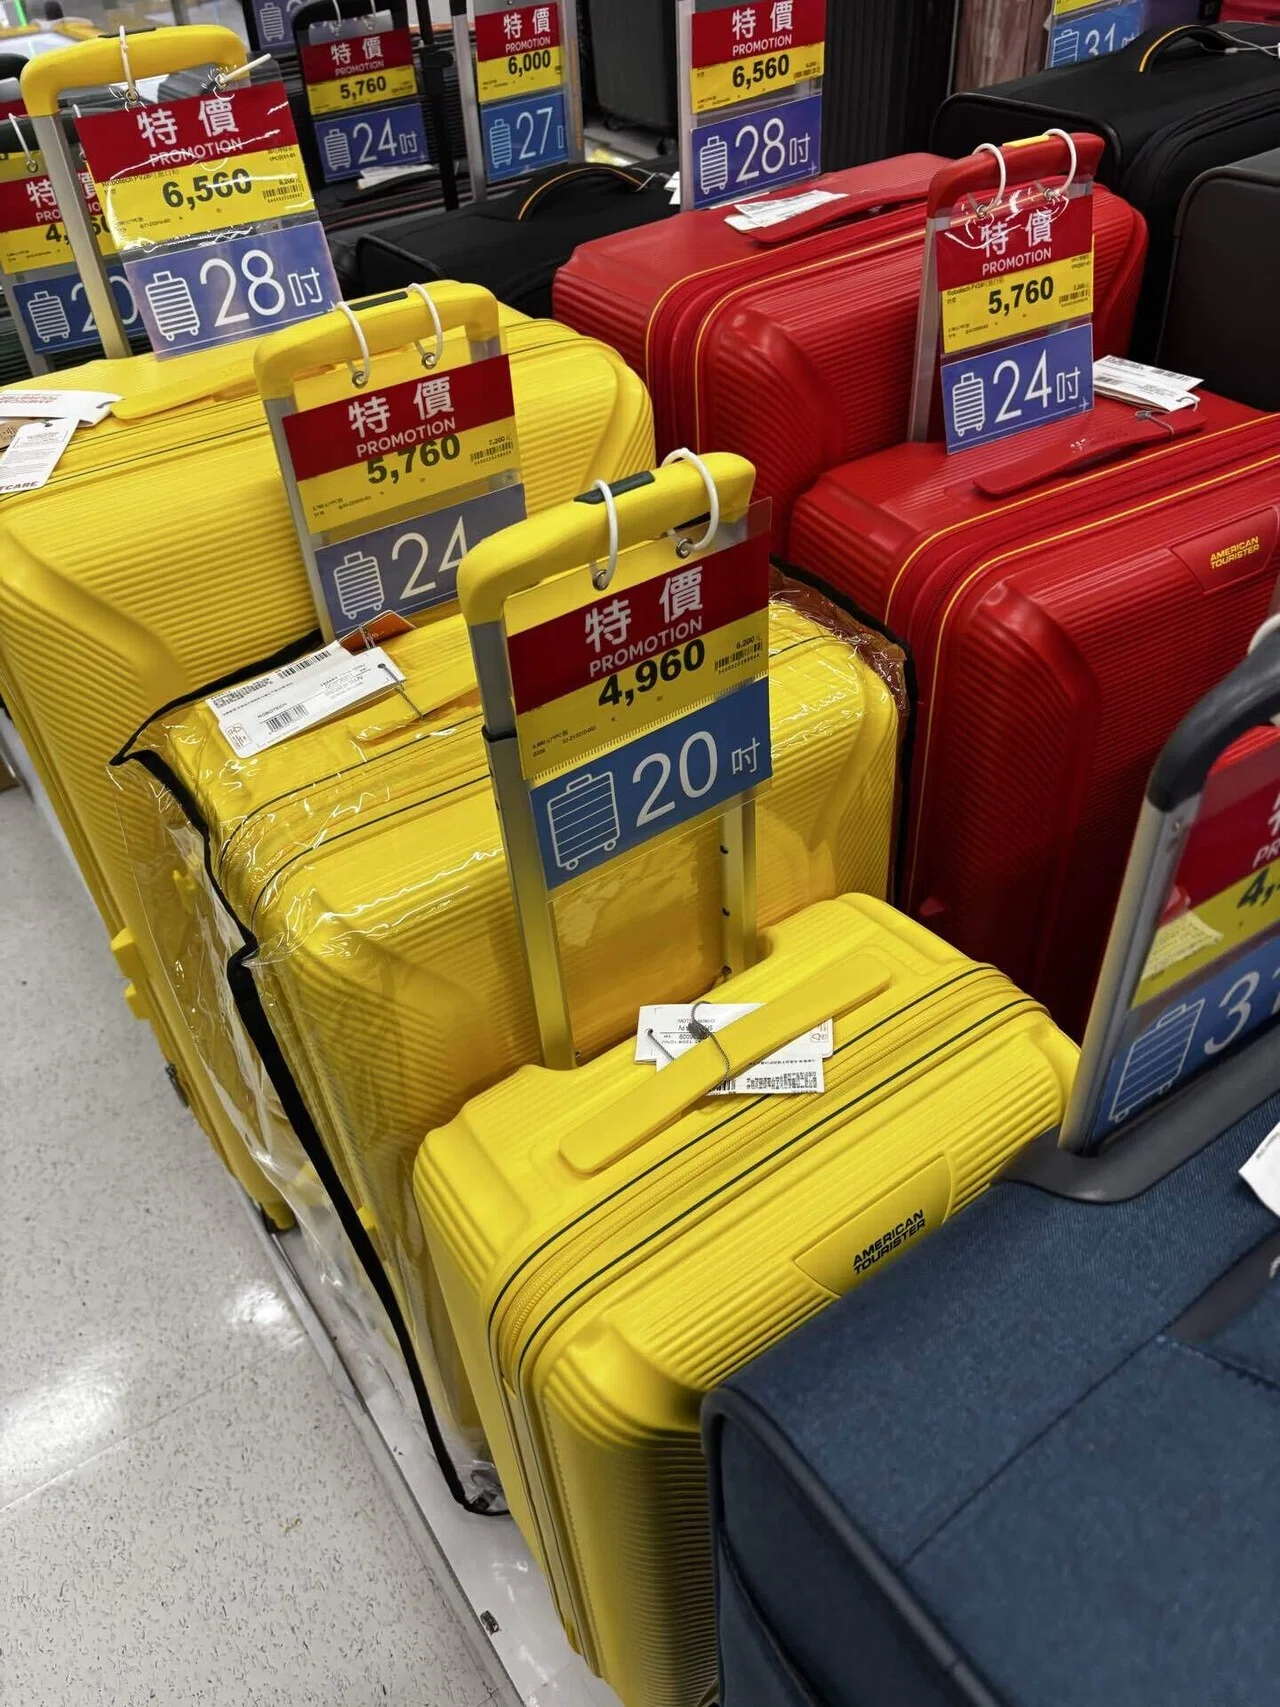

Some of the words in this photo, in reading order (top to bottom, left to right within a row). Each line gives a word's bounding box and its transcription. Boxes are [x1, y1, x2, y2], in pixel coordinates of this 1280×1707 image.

[504, 7, 551, 40] 特價
[732, 0, 793, 40] 特價
[331, 36, 383, 65] 特價
[505, 36, 551, 53] PROMOTION
[508, 50, 551, 77] 6,000
[732, 35, 792, 56] PROMOTION
[335, 60, 384, 76] PROMOTION
[340, 76, 387, 100] 5,760
[732, 54, 789, 90] 6,560
[137, 97, 239, 148] 特價
[149, 137, 243, 167] PROMOTION
[163, 168, 252, 210] 6,560
[980, 209, 1052, 258] 特價
[982, 247, 1052, 276] PROMOTION
[988, 276, 1054, 317] 5,760
[348, 376, 454, 438] 特價
[356, 417, 456, 458] PROMOTION
[367, 433, 460, 485] 5,760
[1210, 535, 1259, 562] AMERICAN
[1210, 544, 1260, 569] TOURISTER
[585, 566, 703, 653] 特價
[590, 616, 702, 678] PROMOTION
[598, 638, 705, 708] 4,960
[853, 1209, 924, 1268] AMERICAN
[853, 1218, 925, 1274] TOURISTER
